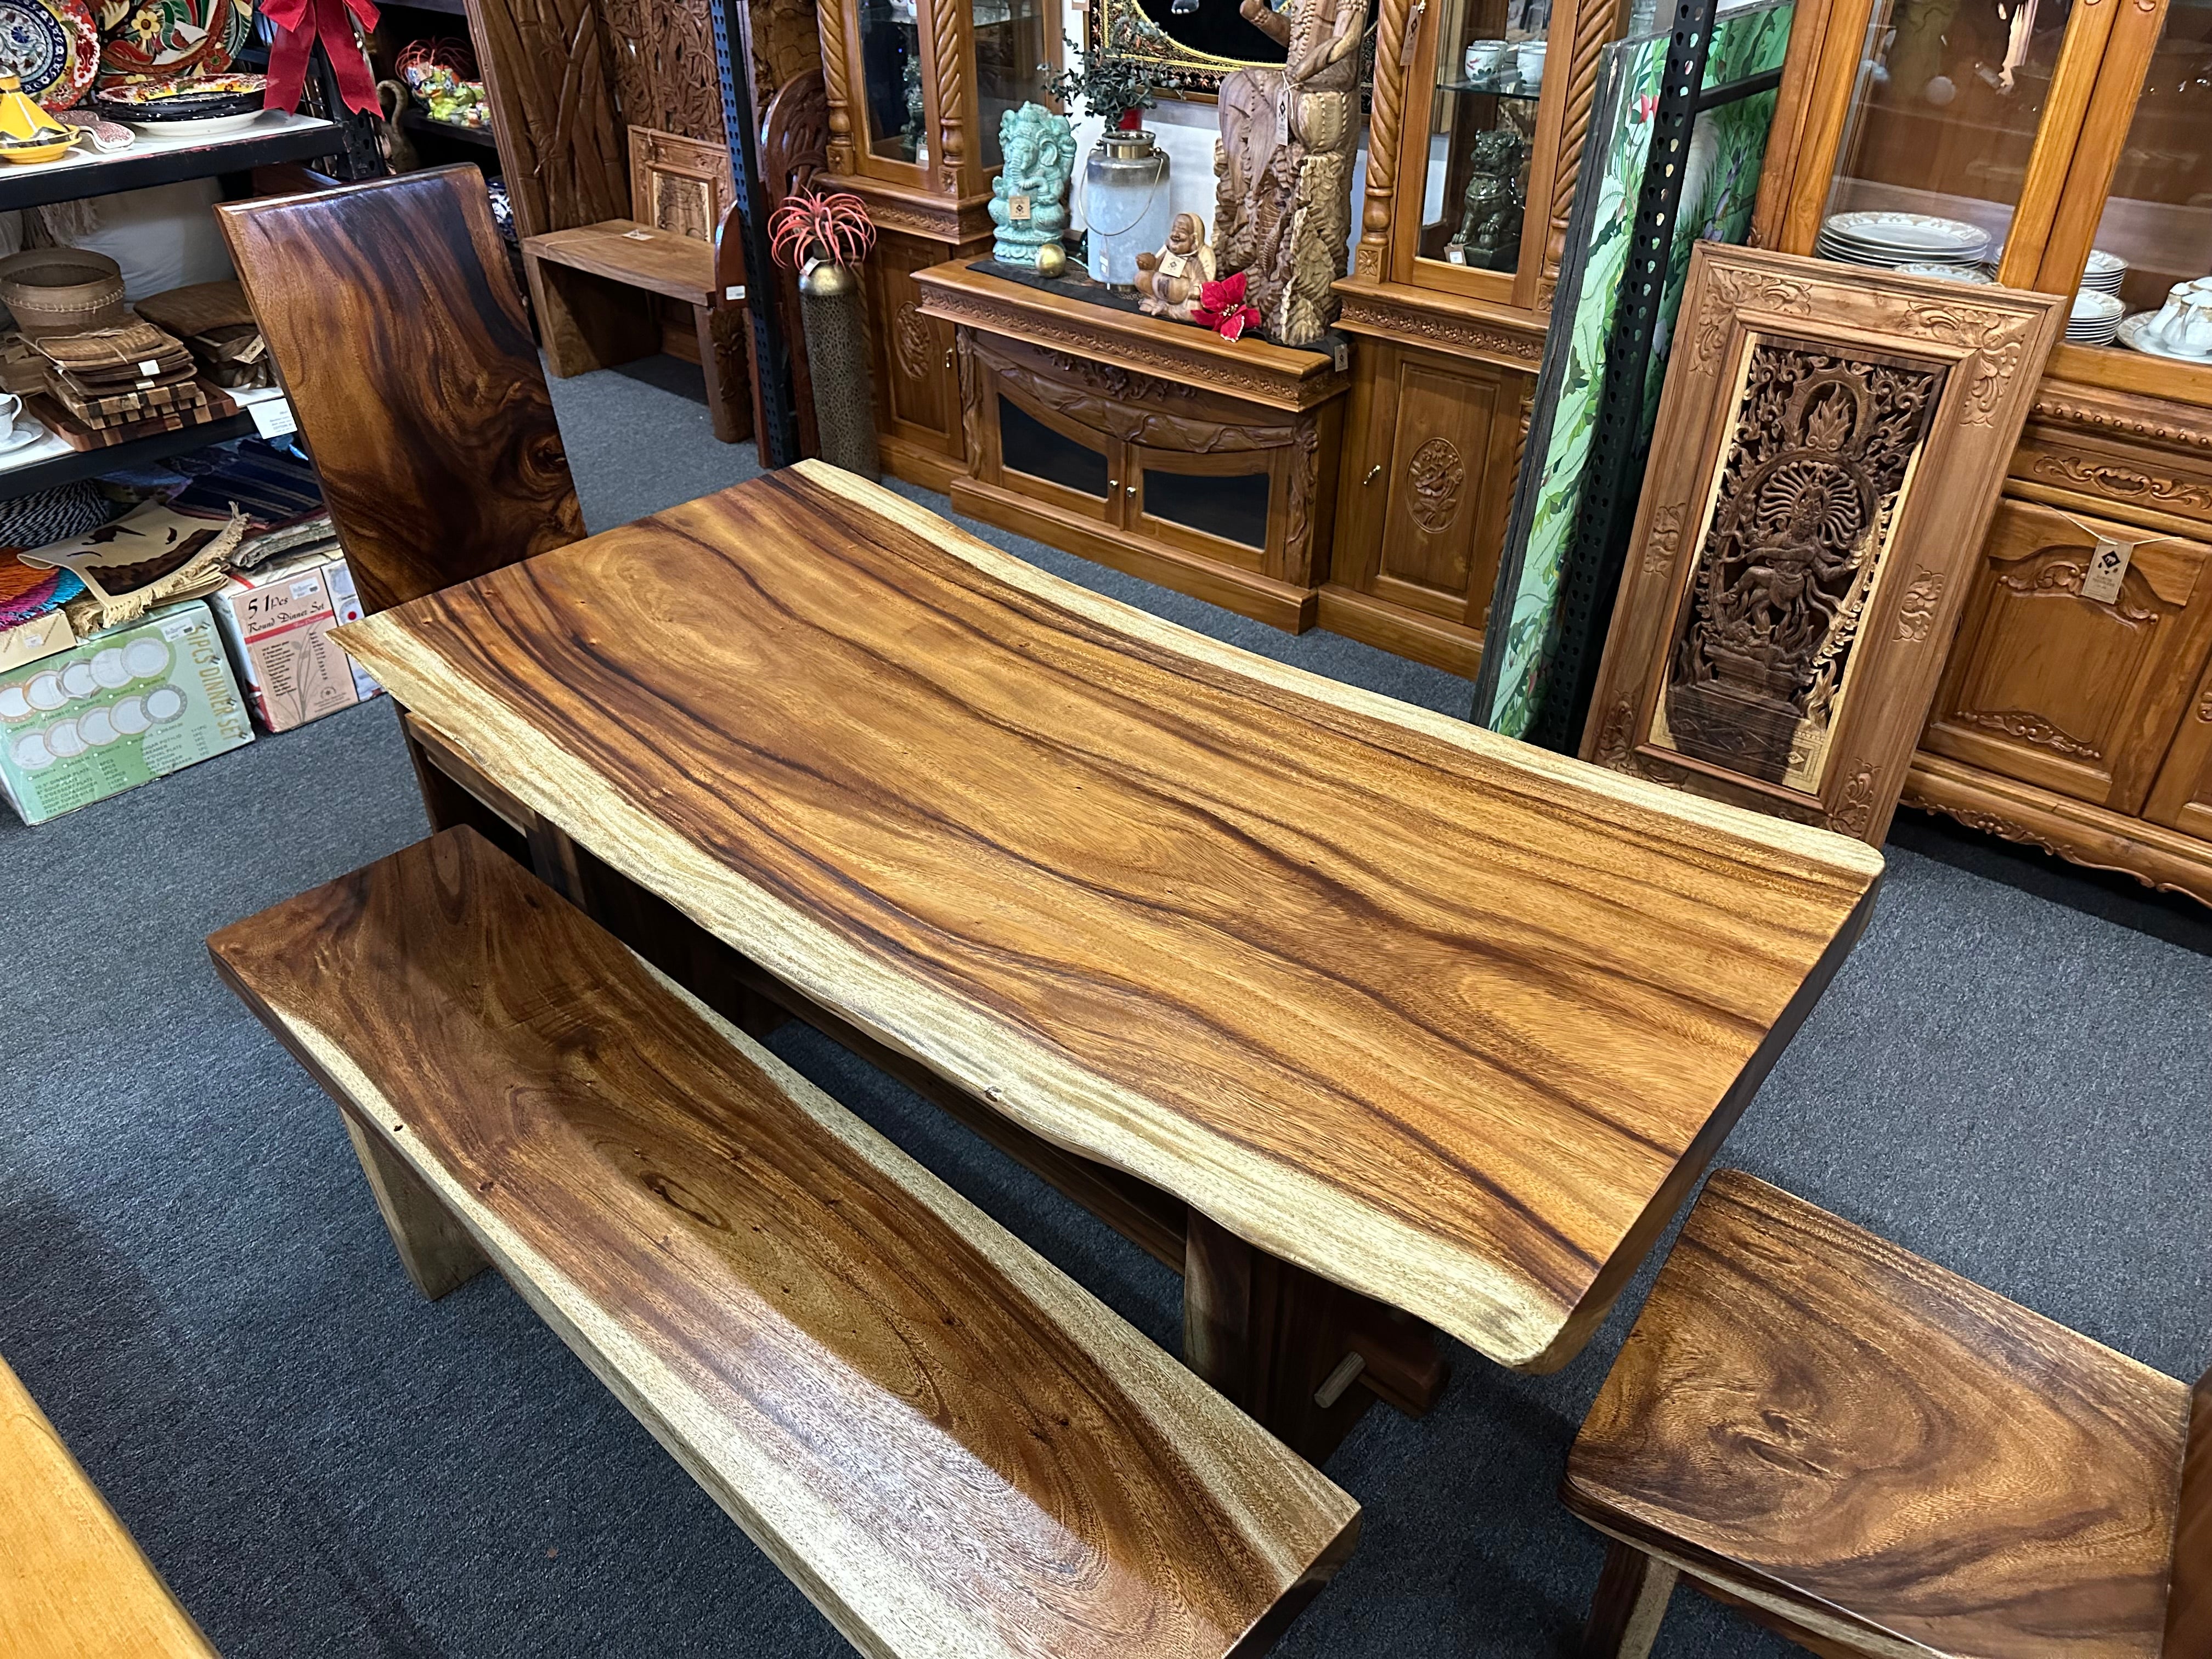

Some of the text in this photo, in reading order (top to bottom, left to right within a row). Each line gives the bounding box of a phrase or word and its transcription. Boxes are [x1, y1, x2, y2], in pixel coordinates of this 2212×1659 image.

[248, 616, 275, 634] Round
[277, 610, 308, 624] Dinner
[310, 601, 325, 613] Set
[199, 667, 235, 716] DINNER
[217, 718, 243, 740] SET
